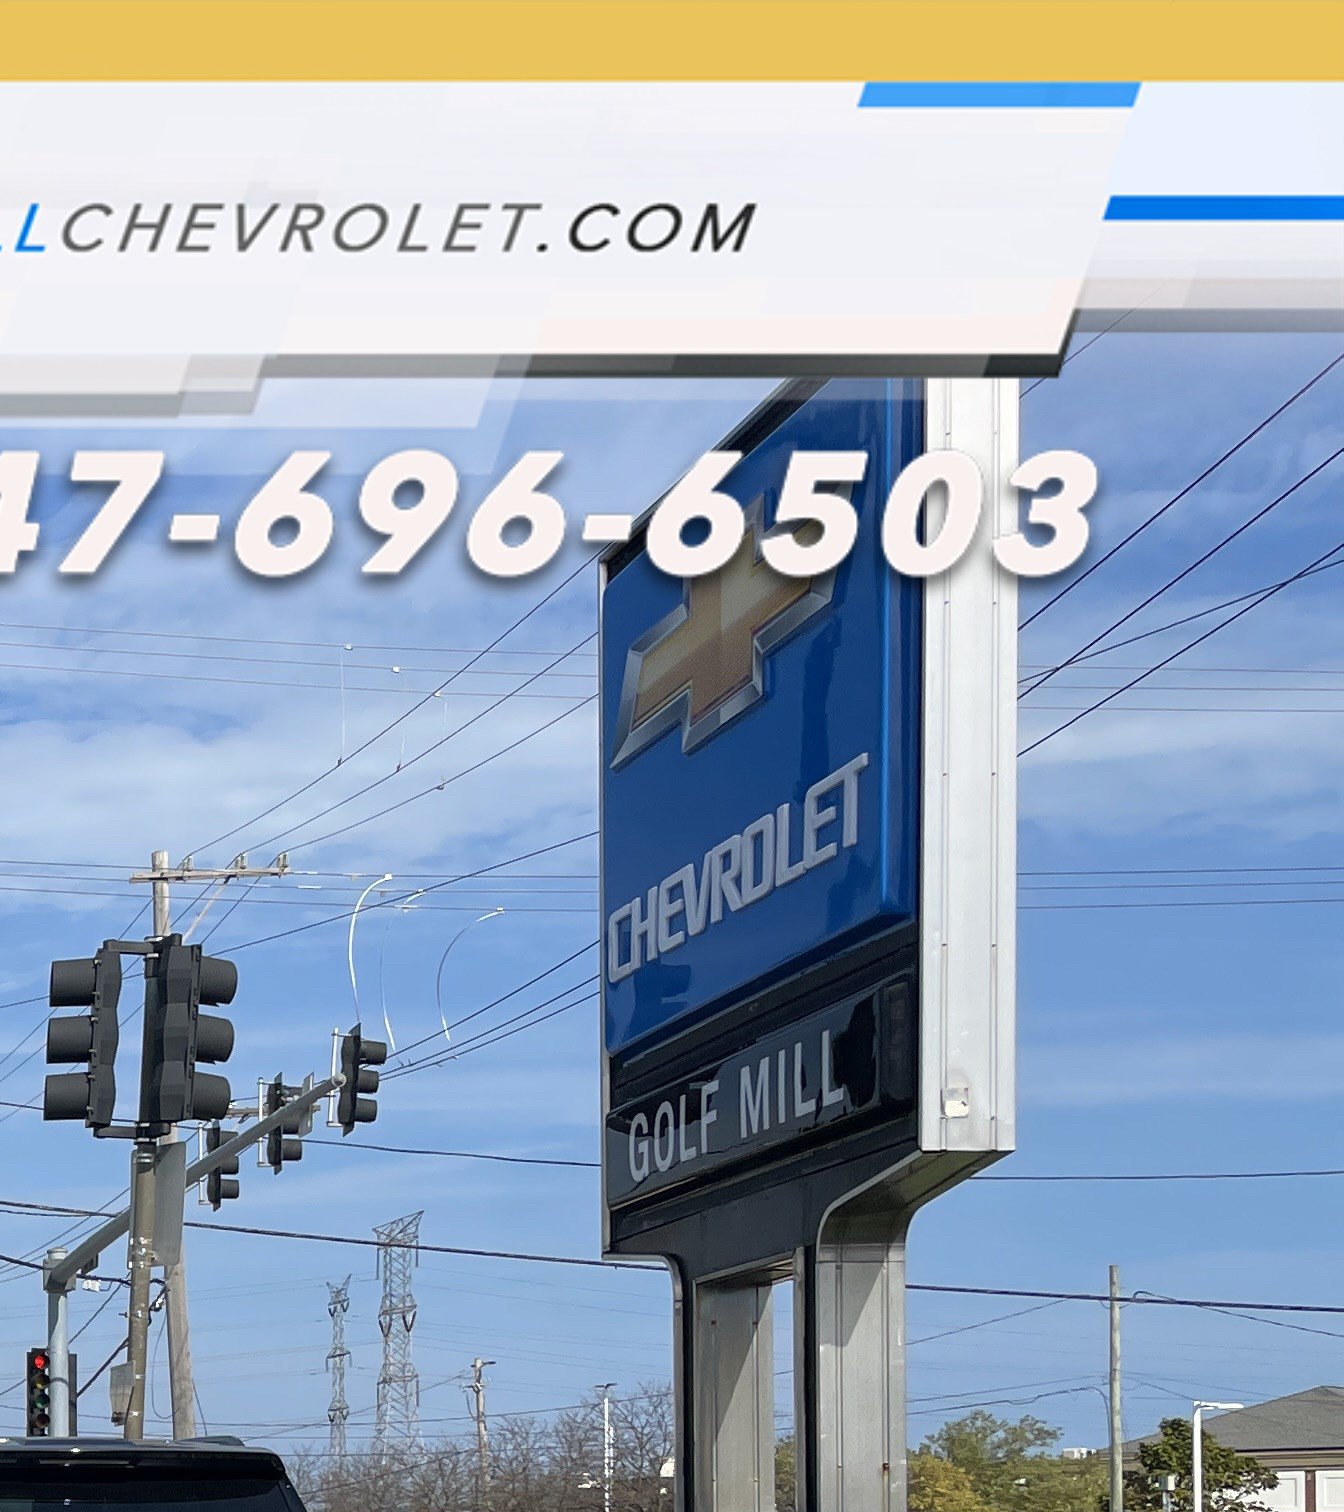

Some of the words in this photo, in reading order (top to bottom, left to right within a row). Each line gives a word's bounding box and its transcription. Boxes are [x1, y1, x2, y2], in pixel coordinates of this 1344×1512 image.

[606, 752, 869, 985] CHEVROLET
[627, 1078, 718, 1184] GOLF
[738, 1028, 846, 1139] MILL
